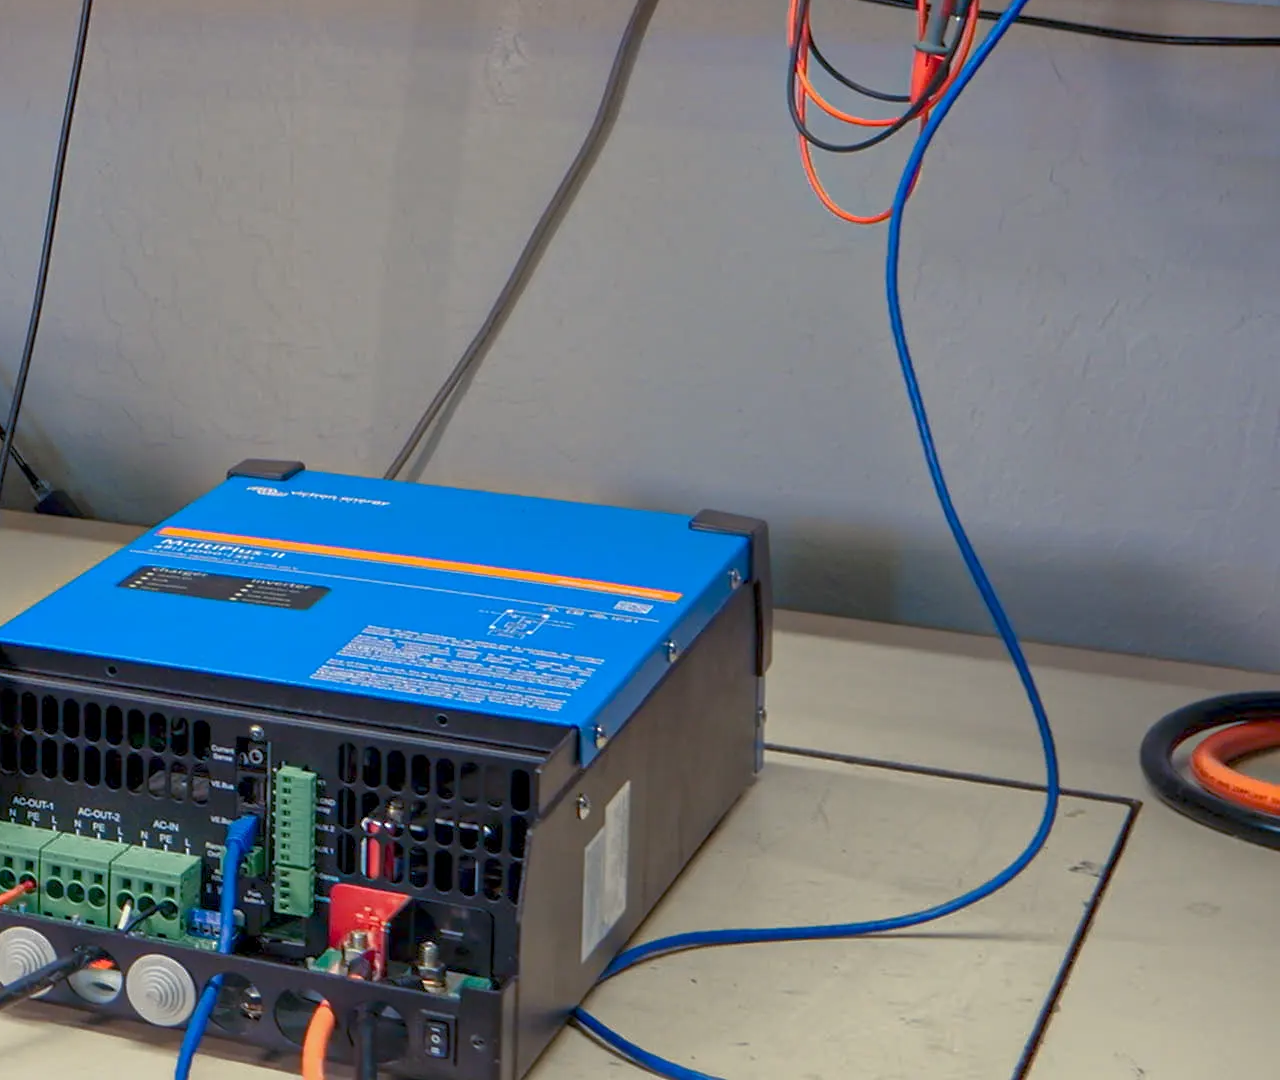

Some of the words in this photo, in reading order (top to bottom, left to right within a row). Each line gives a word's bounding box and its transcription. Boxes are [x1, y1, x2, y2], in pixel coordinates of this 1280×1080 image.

[160, 538, 286, 559] MultiPlus-II
[152, 567, 208, 578] charger
[251, 578, 312, 590] inverter
[211, 744, 235, 755] Current
[212, 752, 233, 762] Sense
[210, 780, 235, 791] VE.Bus
[12, 796, 55, 811] AC-OUT-1
[9, 809, 17, 818] N
[27, 811, 40, 822] PE
[78, 808, 121, 822] AC-OUT-2
[51, 815, 57, 824] L
[74, 820, 82, 829] N
[92, 822, 106, 833] PE
[117, 827, 122, 836] L
[152, 820, 180, 832] AC-IN
[141, 830, 148, 840] N
[159, 834, 173, 845] PE
[184, 838, 191, 847] L
